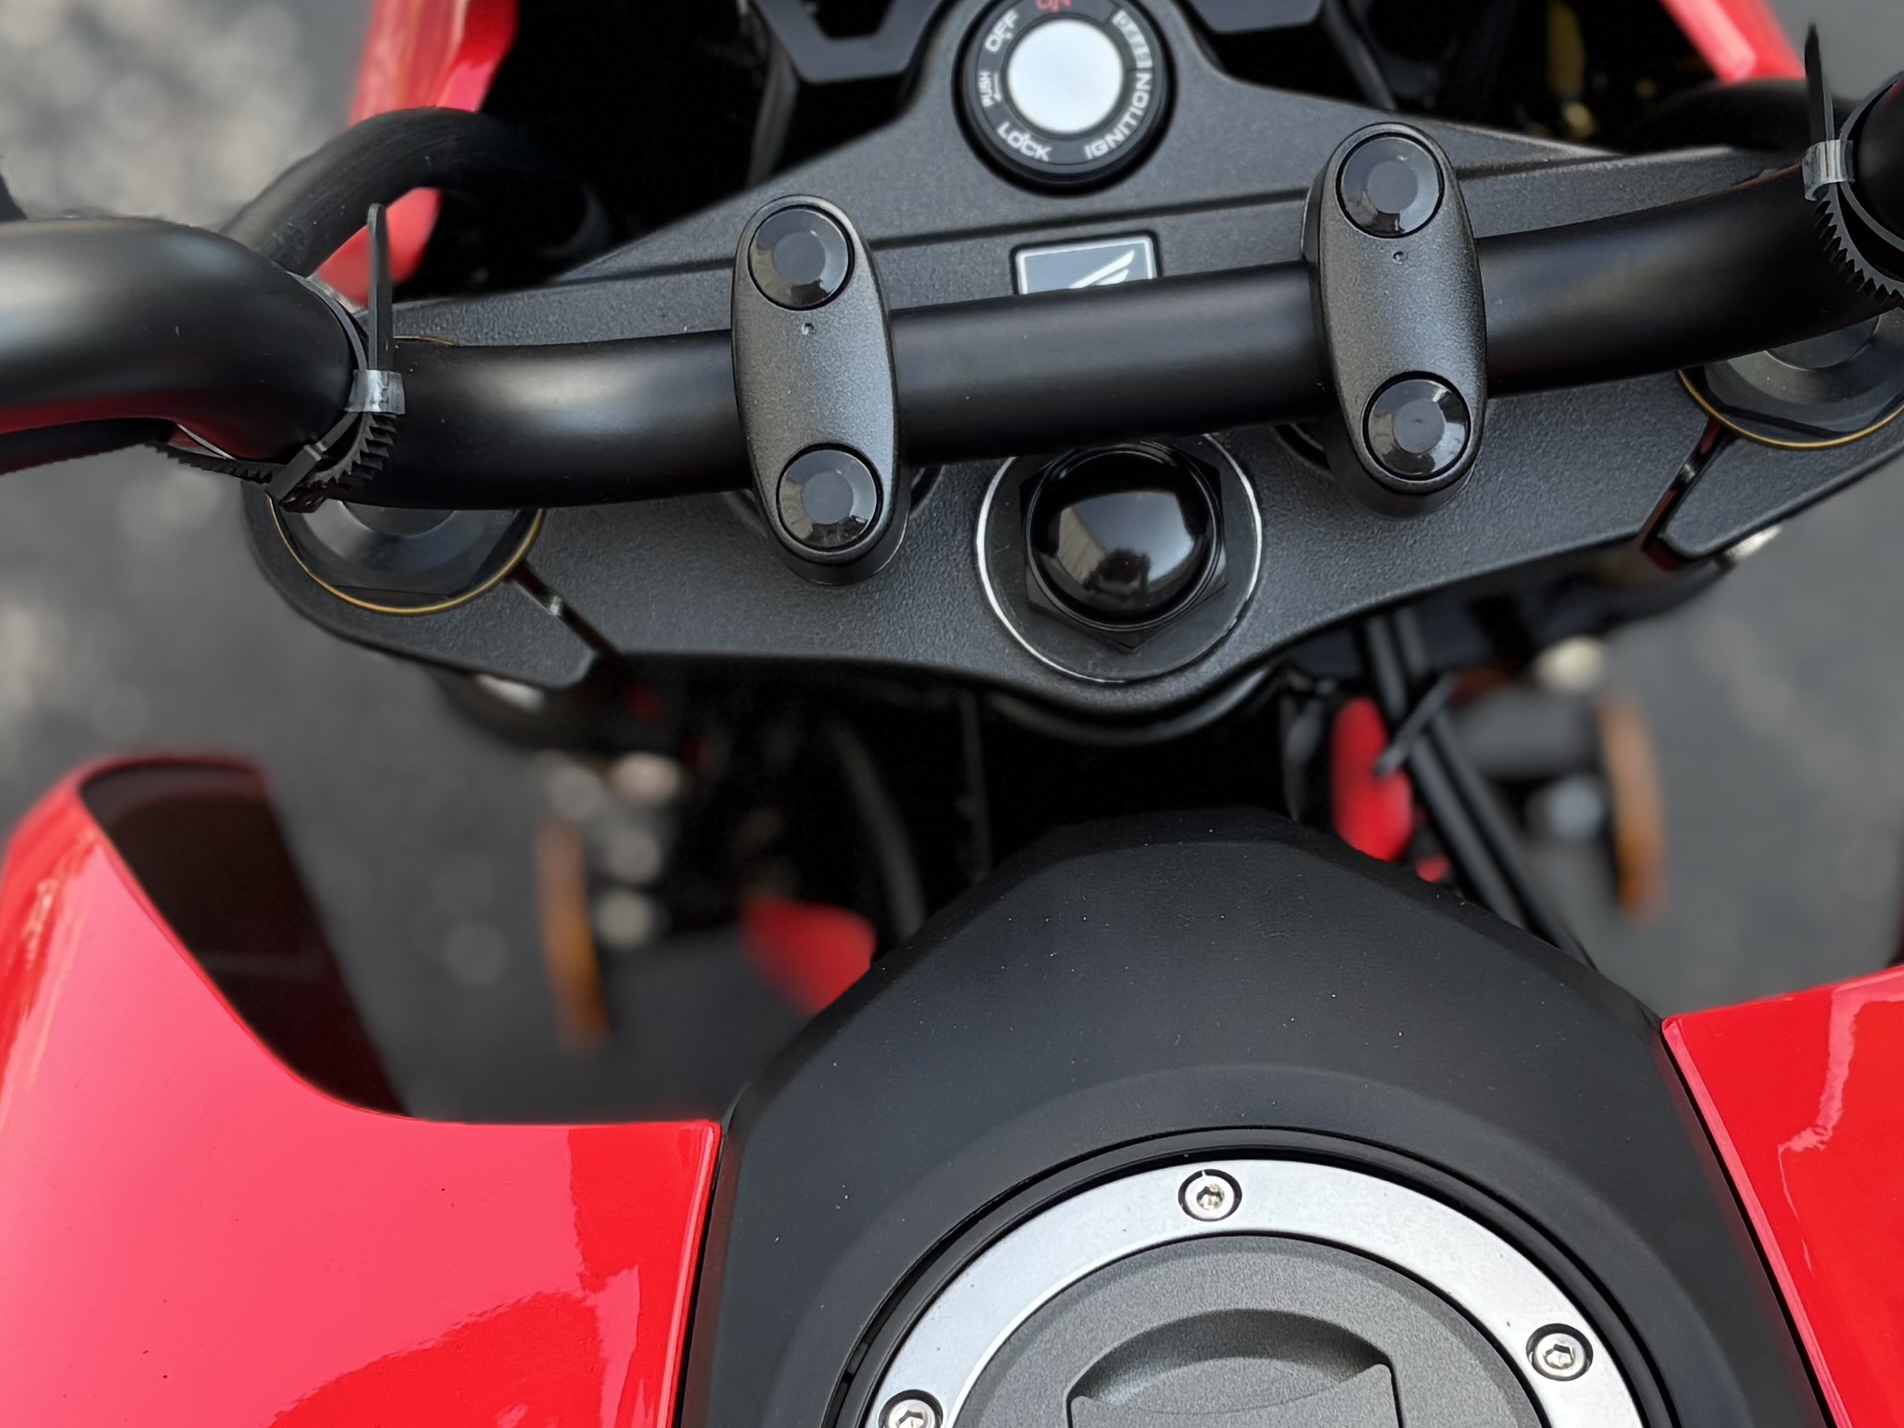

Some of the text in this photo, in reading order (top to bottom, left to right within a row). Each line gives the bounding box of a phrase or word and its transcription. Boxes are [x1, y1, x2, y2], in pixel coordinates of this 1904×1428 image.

[984, 9, 1018, 53] OFF
[977, 70, 995, 108] PUSH
[1083, 72, 1153, 160] IGNITION
[997, 121, 1053, 162] LOCK
